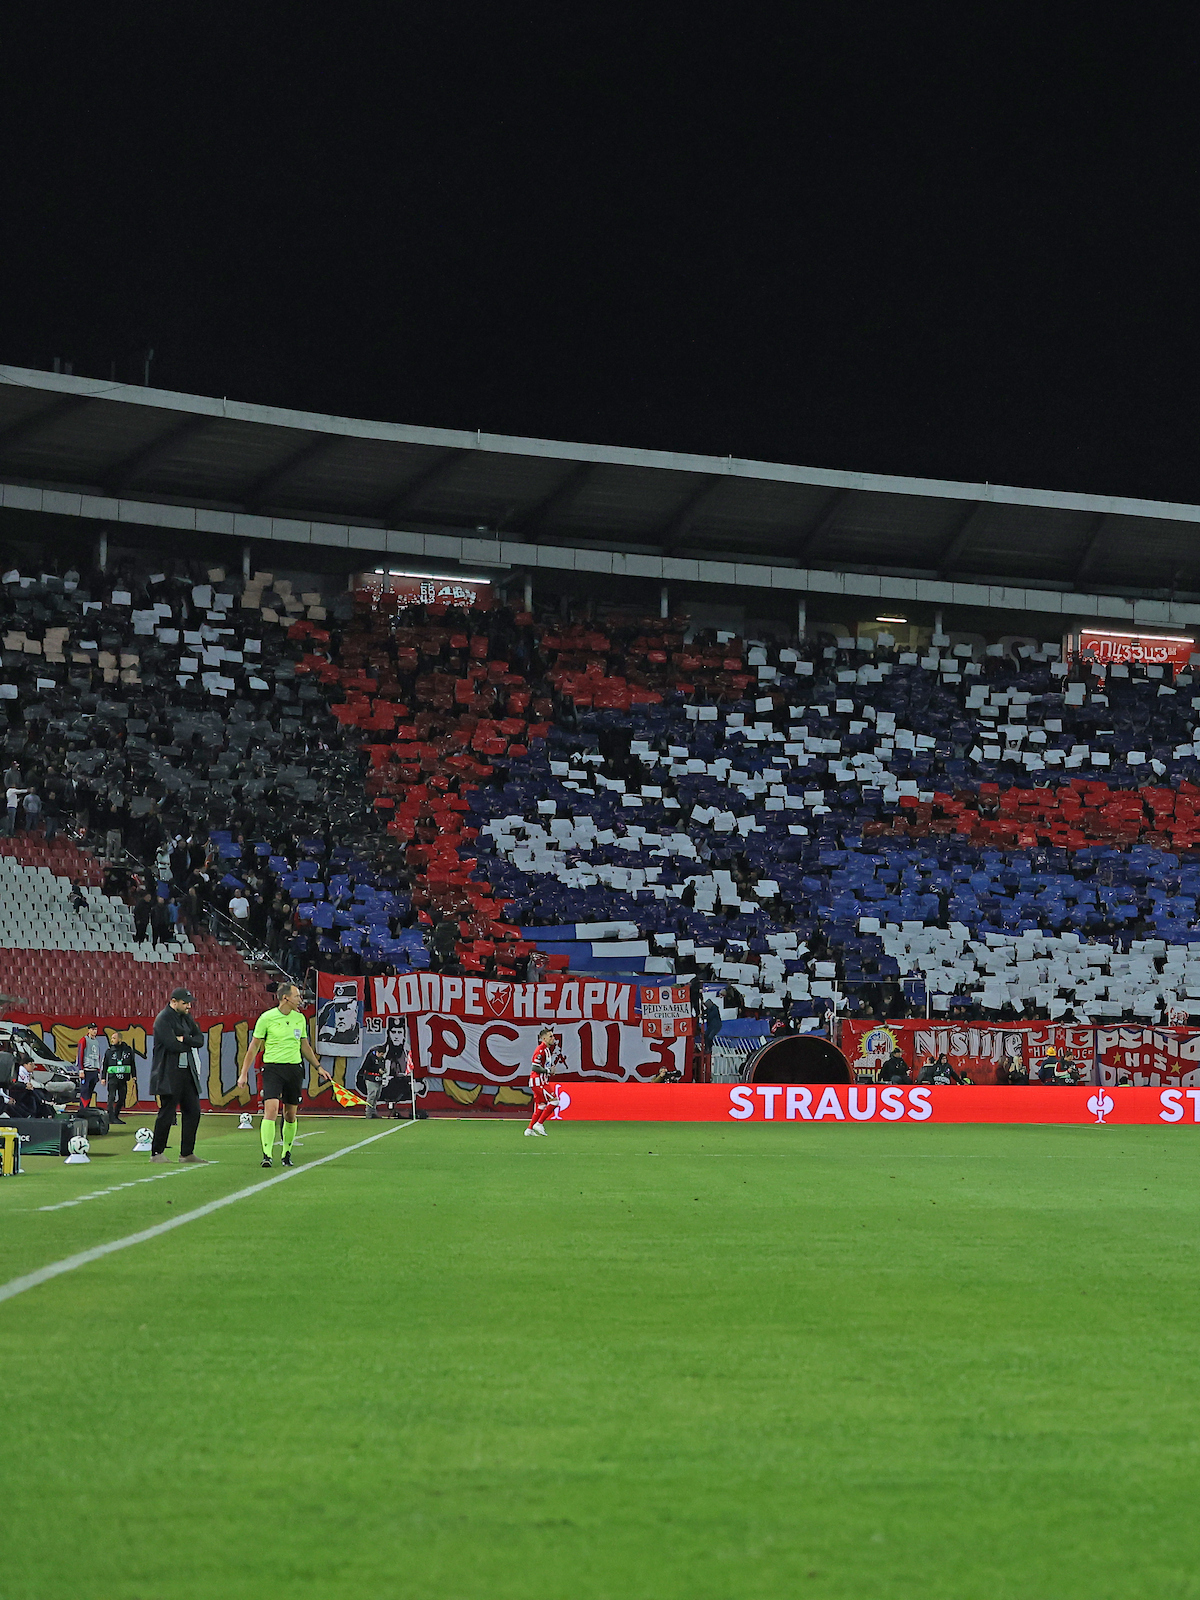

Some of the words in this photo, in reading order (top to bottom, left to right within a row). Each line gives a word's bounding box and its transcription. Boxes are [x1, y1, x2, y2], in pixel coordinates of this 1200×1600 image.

[374, 973, 484, 1015] КОПРЕ
[513, 981, 631, 1021] НЕДРИ
[643, 1003, 690, 1016] РЕПУБЛИКА
[729, 1086, 933, 1121] STRAUSS
